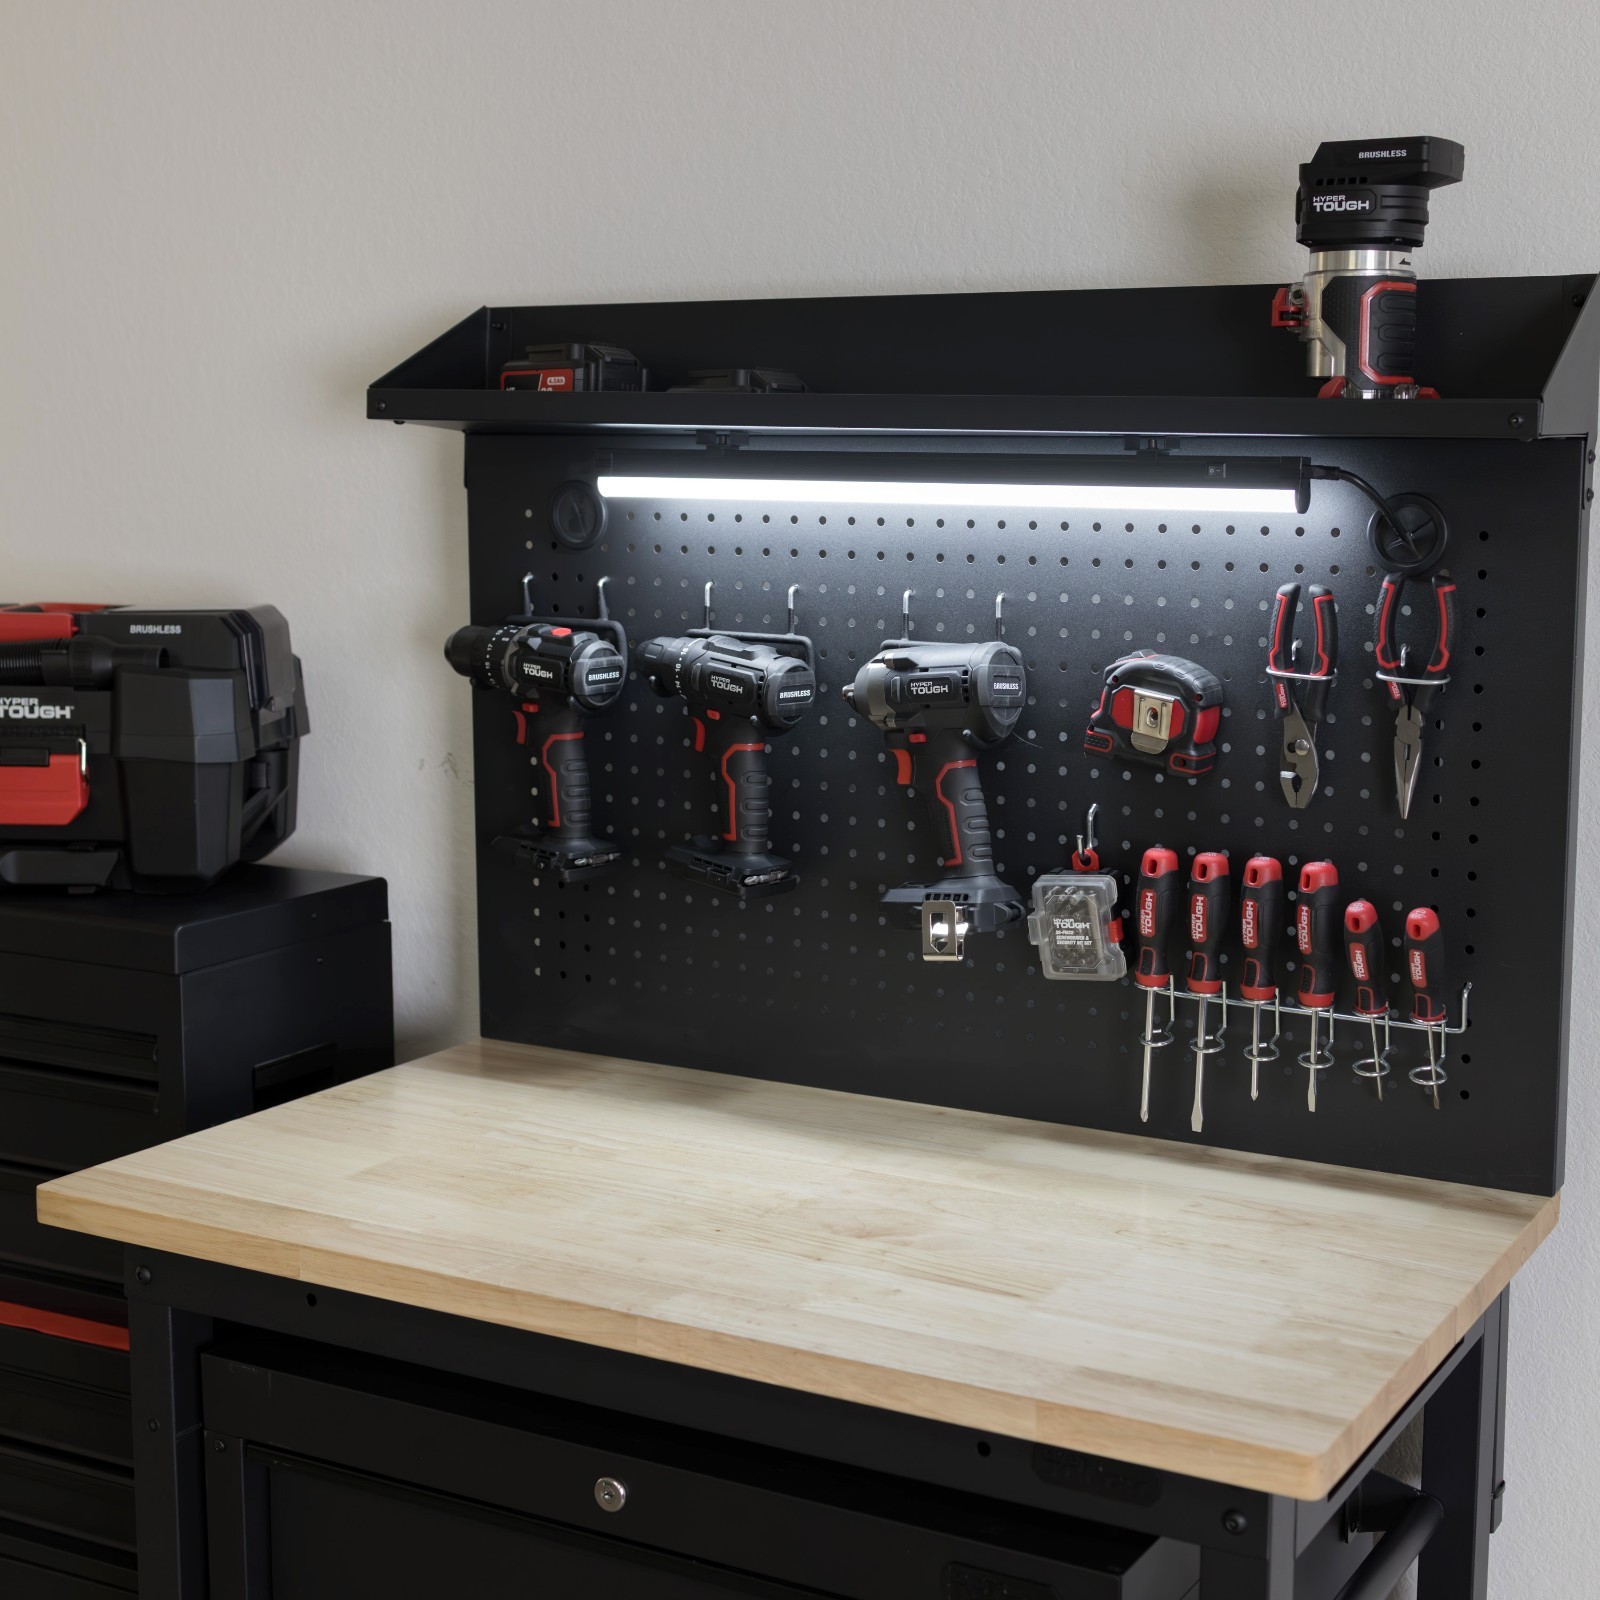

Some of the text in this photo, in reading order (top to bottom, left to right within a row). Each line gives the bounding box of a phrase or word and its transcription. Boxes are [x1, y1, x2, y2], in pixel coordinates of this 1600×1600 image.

[1358, 149, 1407, 159] BRUSHLESS
[1313, 194, 1346, 202] HYPER
[1313, 200, 1370, 212] TOUGH
[129, 624, 182, 635] BRUSHLESS
[523, 662, 542, 670] HYPER
[523, 667, 554, 680] TOUGH
[588, 671, 620, 682] BRUSHLESS
[711, 674, 731, 684] HYPER
[711, 679, 743, 694] TOUGH
[911, 685, 949, 695] TOUGH
[993, 681, 1019, 690] BRUSHLESS
[779, 689, 811, 700] BRUSHLESS
[1145, 892, 1154, 935] TOUGH
[1195, 896, 1204, 940] TOUGH
[1246, 901, 1254, 945] TOUGH
[1301, 906, 1309, 950] TOUGH
[1355, 950, 1366, 979] TOUGH
[1414, 951, 1423, 981] TOUGH
